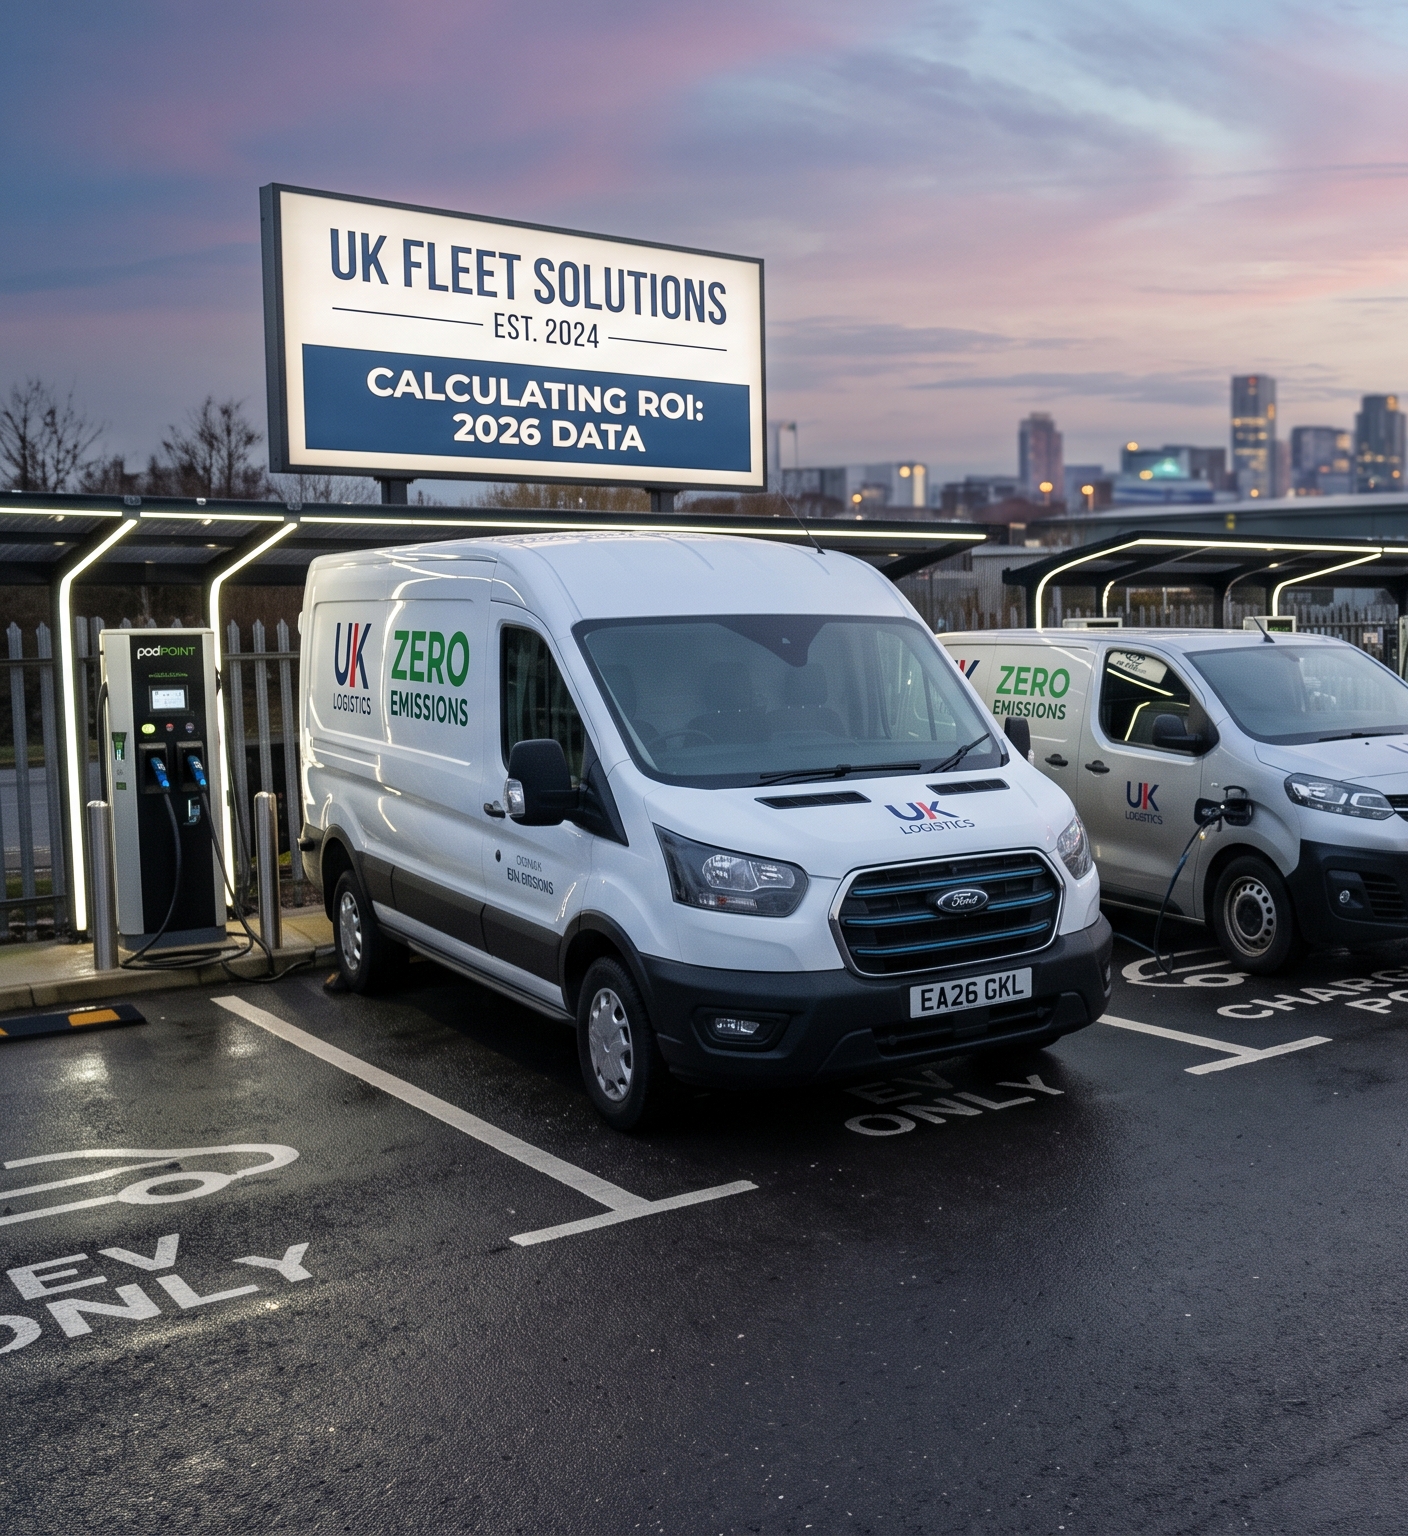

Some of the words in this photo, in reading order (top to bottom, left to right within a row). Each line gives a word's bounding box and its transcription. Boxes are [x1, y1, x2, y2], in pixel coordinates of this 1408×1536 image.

[330, 228, 389, 285] UK
[402, 238, 521, 300] FLEET
[533, 258, 727, 326] SOLUTIONS
[494, 312, 538, 343] EST.
[545, 318, 600, 349] 2024
[366, 366, 626, 415] CALCULATING
[638, 390, 704, 422] ROI:
[452, 412, 542, 447] 2026
[552, 419, 647, 452] DATA
[137, 645, 196, 660] podPOINT
[334, 622, 372, 689] UK
[391, 630, 470, 687] ZERO
[996, 665, 1070, 699] ZERO
[333, 693, 371, 716] LOGISTICS
[390, 690, 468, 726] EMISSIONS
[992, 700, 1067, 720] EMISSIONS
[884, 801, 959, 821] UK
[1127, 781, 1159, 812] UK
[900, 819, 975, 835] LOGISTICS
[920, 981, 978, 1011] EA26
[984, 973, 1024, 998] GKL
[843, 1070, 954, 1105] EV
[844, 1074, 1065, 1136] ONLY
[6, 1233, 180, 1300] EV
